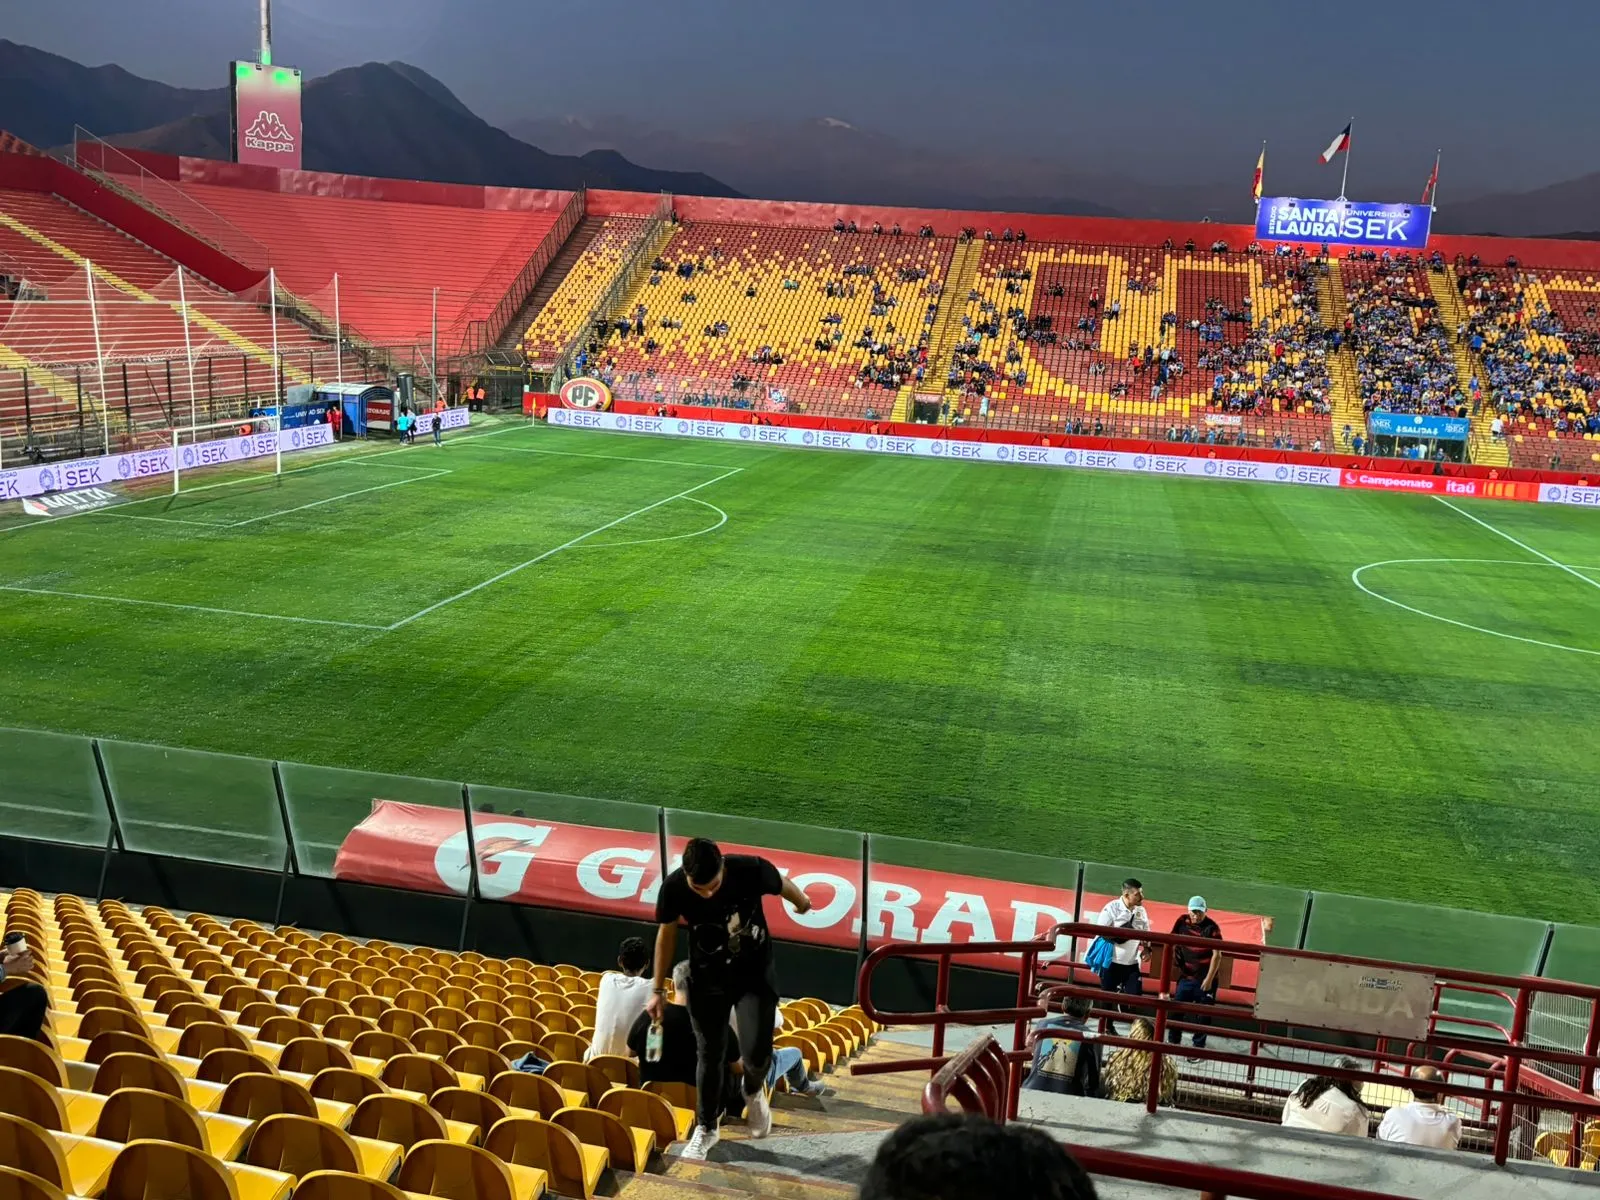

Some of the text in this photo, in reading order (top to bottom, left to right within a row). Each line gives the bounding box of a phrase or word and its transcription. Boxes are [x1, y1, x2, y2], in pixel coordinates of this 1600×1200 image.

[245, 137, 294, 152] Kappa
[1268, 206, 1277, 234] ESTADIO
[1278, 206, 1339, 224] SANTA
[1345, 210, 1410, 219] UNIVERSIDAD
[1276, 220, 1338, 238] LAURA
[1344, 217, 1409, 240] SEK
[571, 385, 596, 406] PF
[420, 420, 432, 432] SE
[450, 414, 464, 426] SEK
[574, 415, 601, 426] SEK
[635, 420, 662, 432] SEK
[697, 425, 725, 437] SEK
[759, 431, 787, 442] SEK
[1402, 426, 1433, 435] SALIDA
[306, 430, 328, 445] SEK
[822, 436, 851, 448] SEK
[886, 441, 915, 453] SEK
[952, 446, 981, 458] SEK
[202, 446, 228, 463] SEK
[1018, 451, 1048, 462] SEK
[138, 456, 170, 474] SEK
[1086, 456, 1116, 467] SEK
[1155, 461, 1186, 473] SEK
[66, 466, 102, 486] SEK
[1226, 466, 1259, 478] SEK
[1298, 471, 1330, 483] SEK
[1359, 475, 1433, 488] Campeonato
[1446, 480, 1476, 493] itaú
[577, 847, 1100, 964] GORAD
